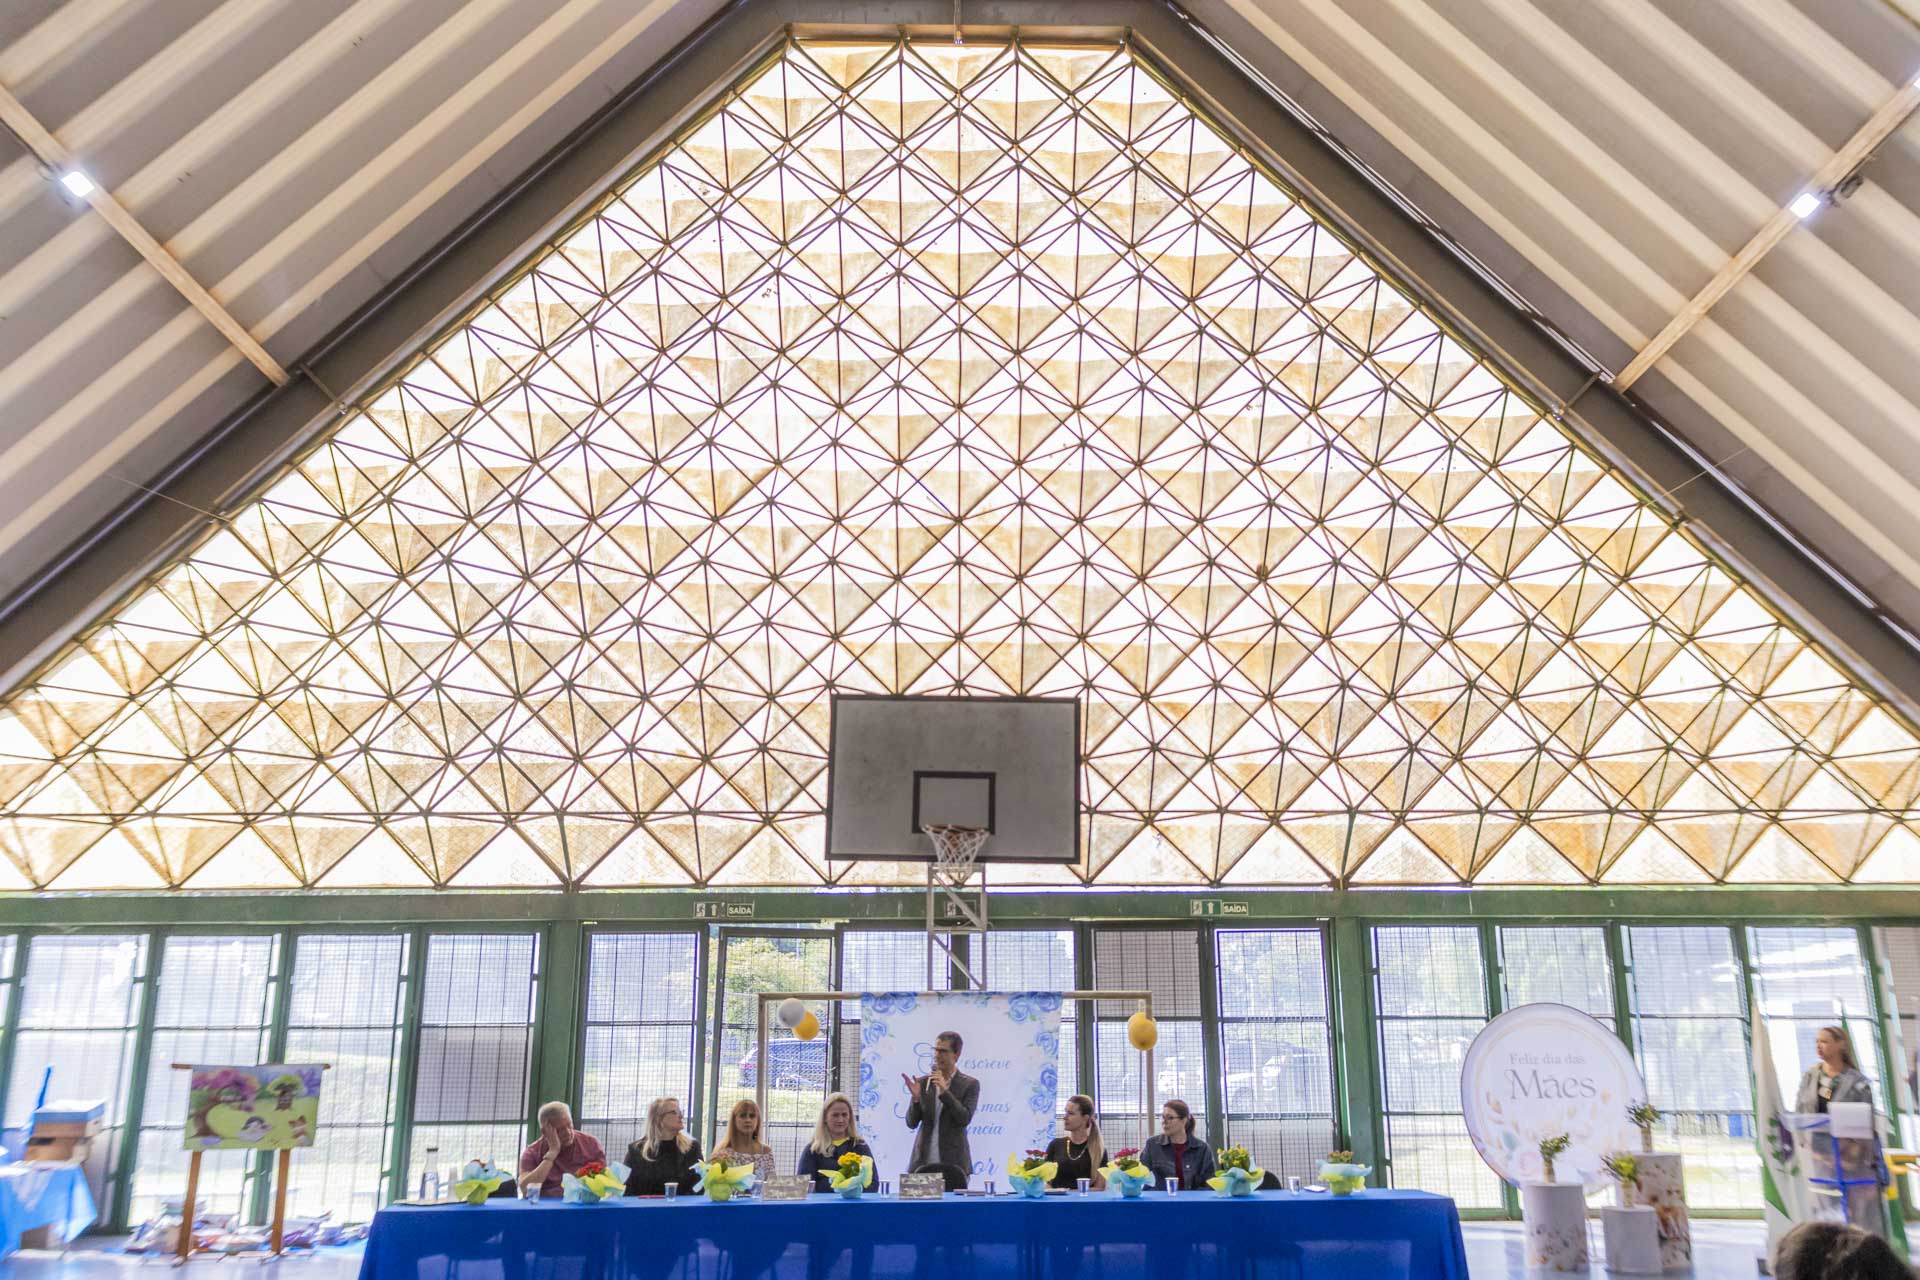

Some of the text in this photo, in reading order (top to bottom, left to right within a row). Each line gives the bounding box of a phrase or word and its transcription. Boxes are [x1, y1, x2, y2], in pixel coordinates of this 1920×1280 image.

[729, 905, 752, 915] SAÍDA
[1542, 1052, 1562, 1065] dia
[980, 1102, 1011, 1113] mas
